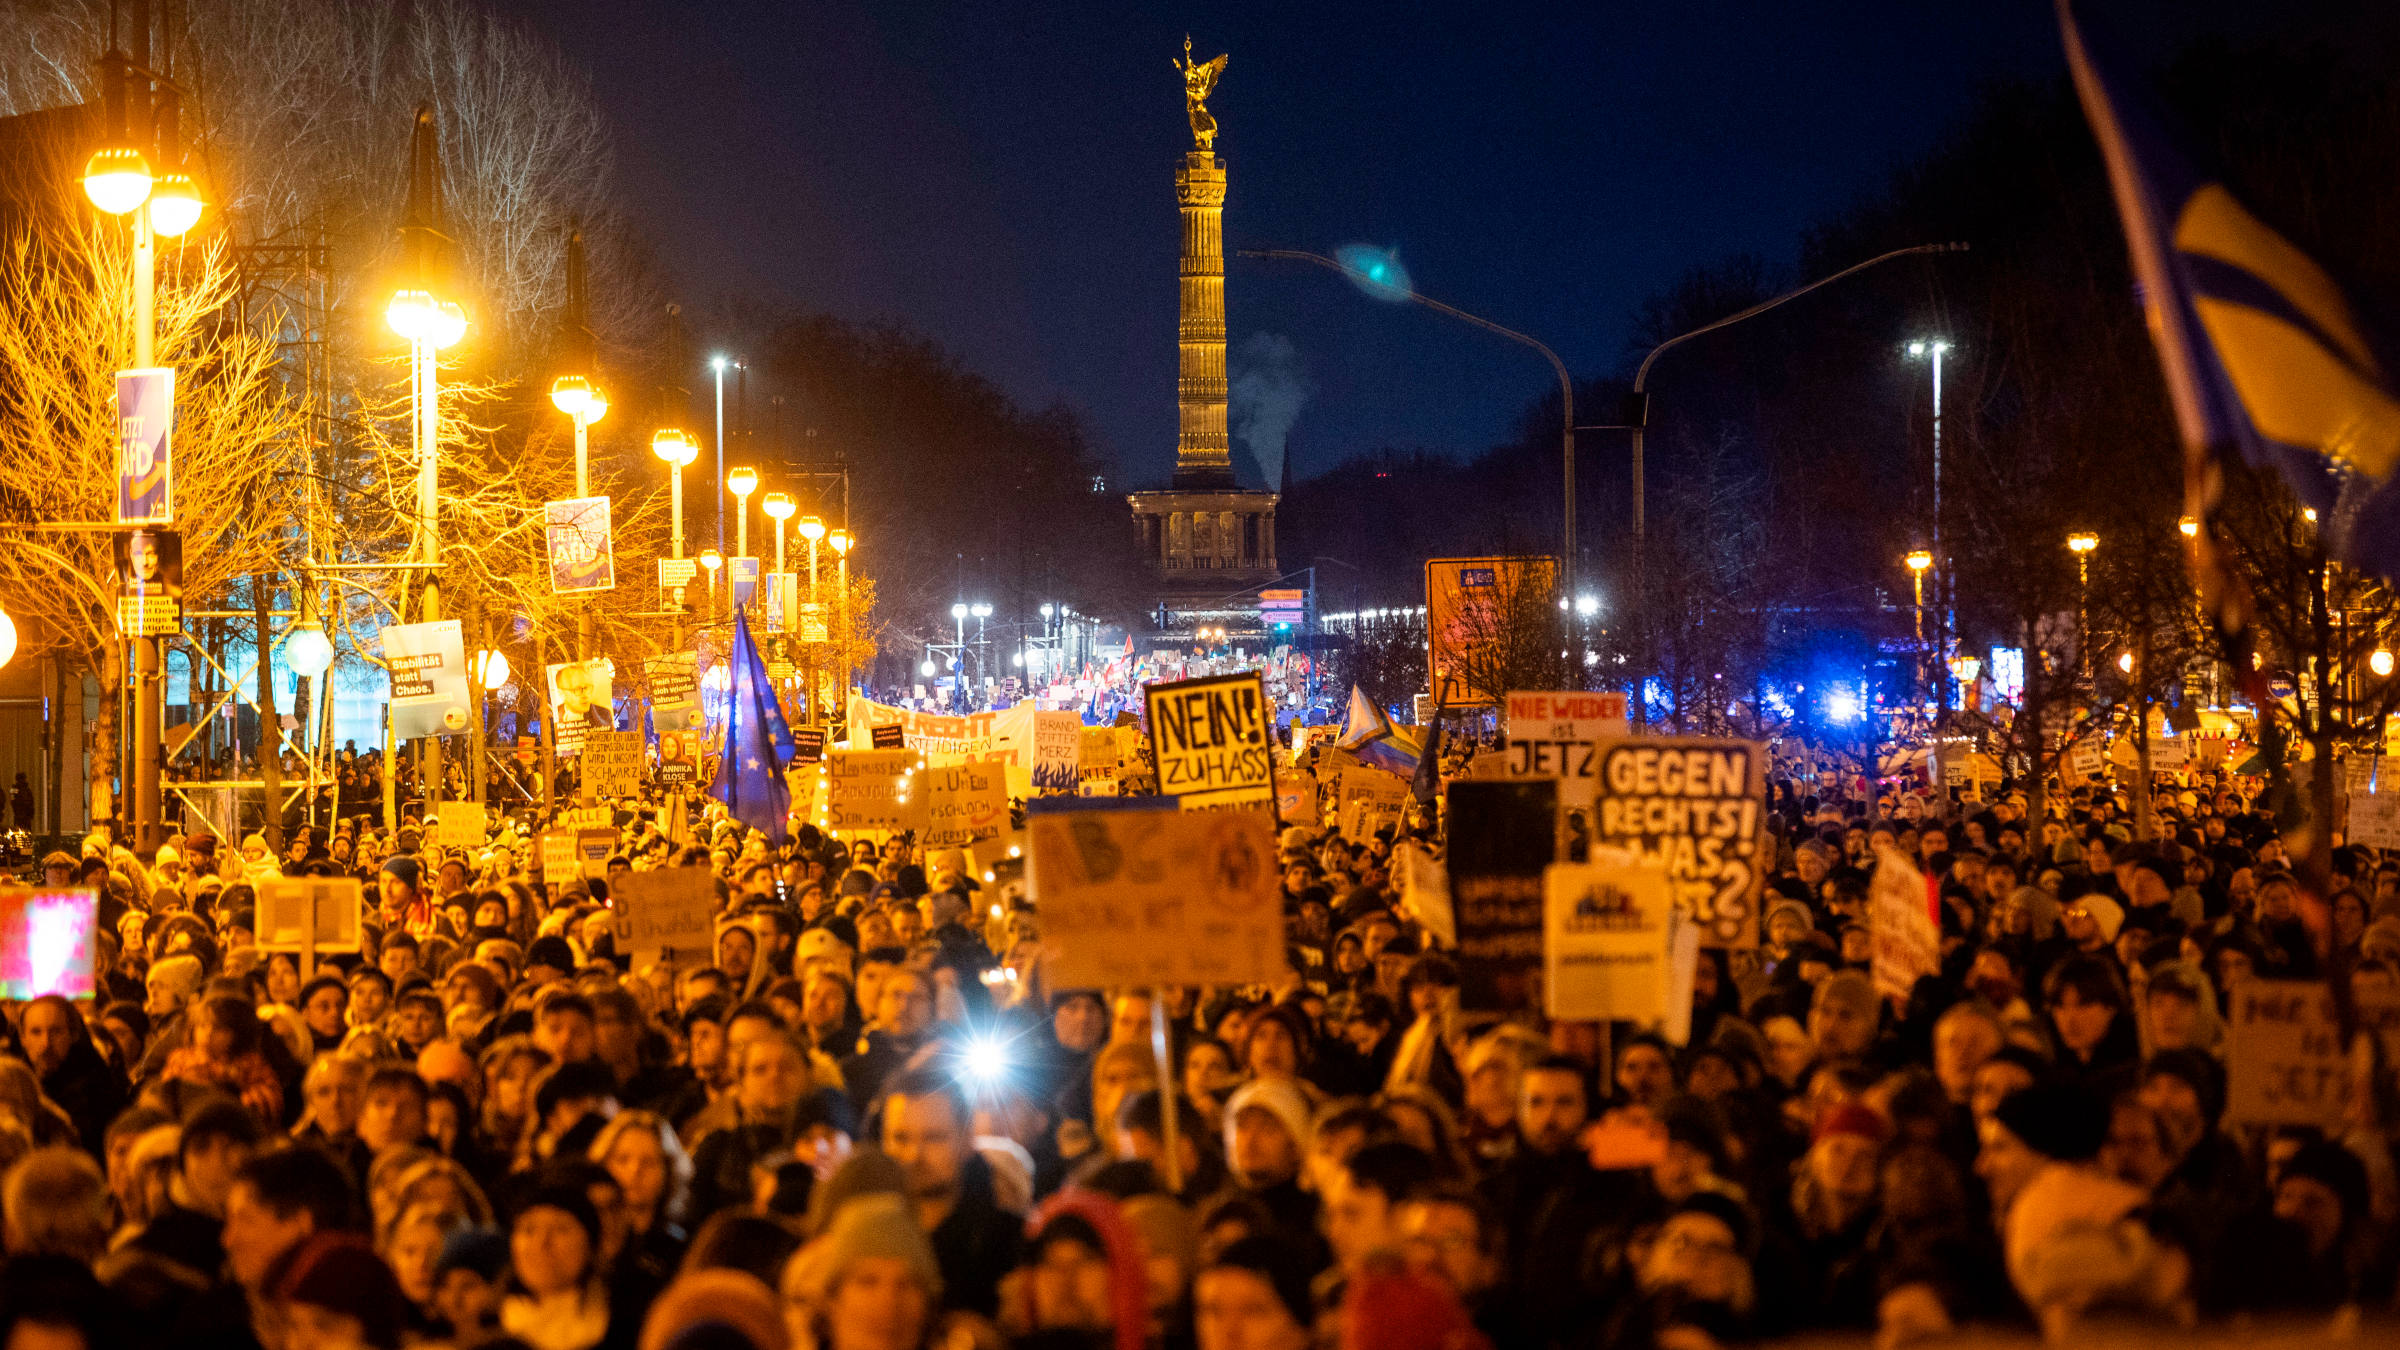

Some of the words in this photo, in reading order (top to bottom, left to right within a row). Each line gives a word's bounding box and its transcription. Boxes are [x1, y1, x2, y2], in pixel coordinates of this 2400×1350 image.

[392, 655, 441, 670] Stabilität
[394, 671, 419, 683] statt
[395, 684, 432, 696] Chaos.
[669, 684, 695, 694] wieder
[654, 694, 682, 704] lohnen.
[1510, 697, 1548, 721] NIE
[1158, 688, 1261, 753] NEIN!
[1039, 745, 1072, 759] MERZ
[1511, 741, 1595, 777] JETZ
[586, 766, 638, 779] SCHWARZ
[662, 765, 692, 773] ANNIKA
[1605, 746, 1749, 798] GEGEN
[662, 773, 686, 781] KLOSE
[597, 784, 626, 796] BLAU
[568, 809, 601, 825] ALLE
[1601, 799, 1758, 855] RECHTS!
